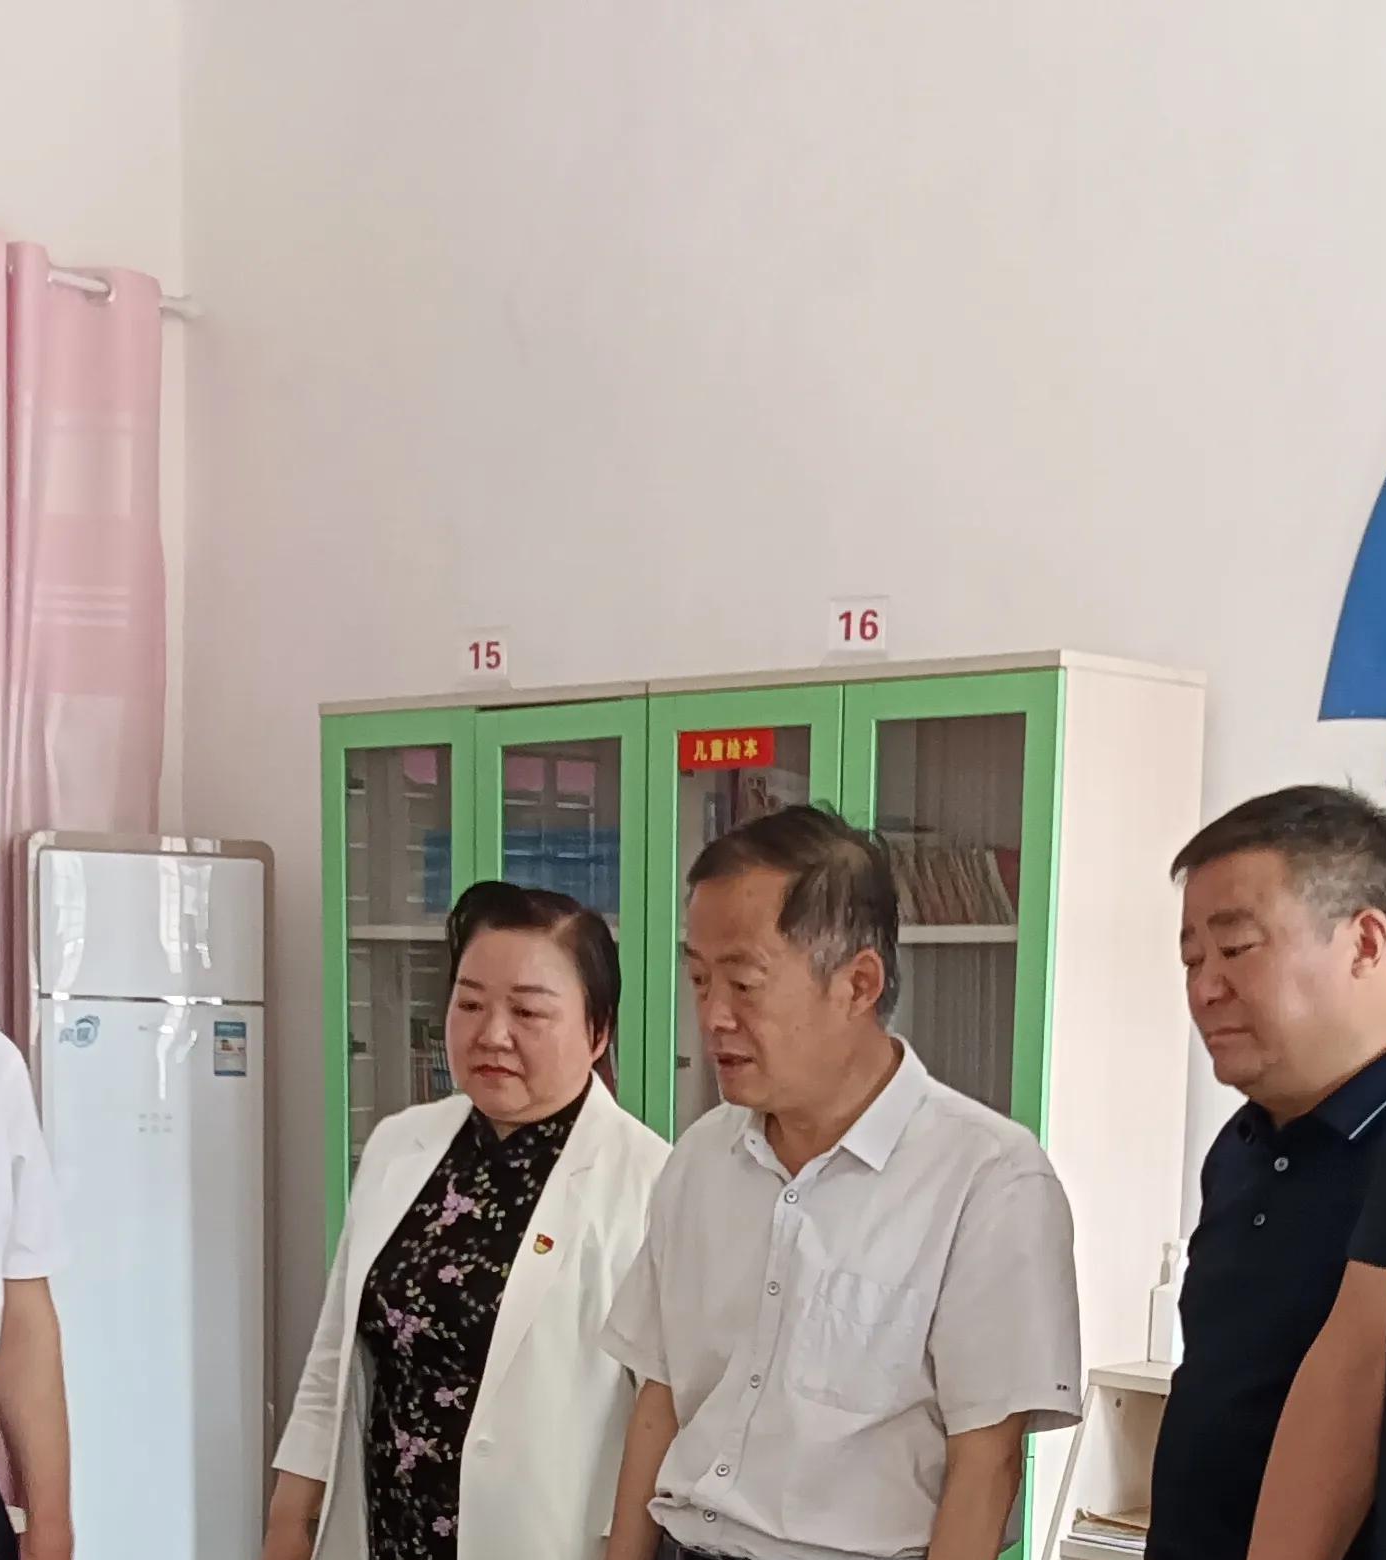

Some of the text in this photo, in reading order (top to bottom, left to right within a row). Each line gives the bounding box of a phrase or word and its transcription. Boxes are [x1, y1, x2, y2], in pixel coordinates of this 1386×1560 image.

[838, 609, 879, 641] 16
[468, 640, 502, 671] 15
[693, 735, 758, 762] 儿童绘本
